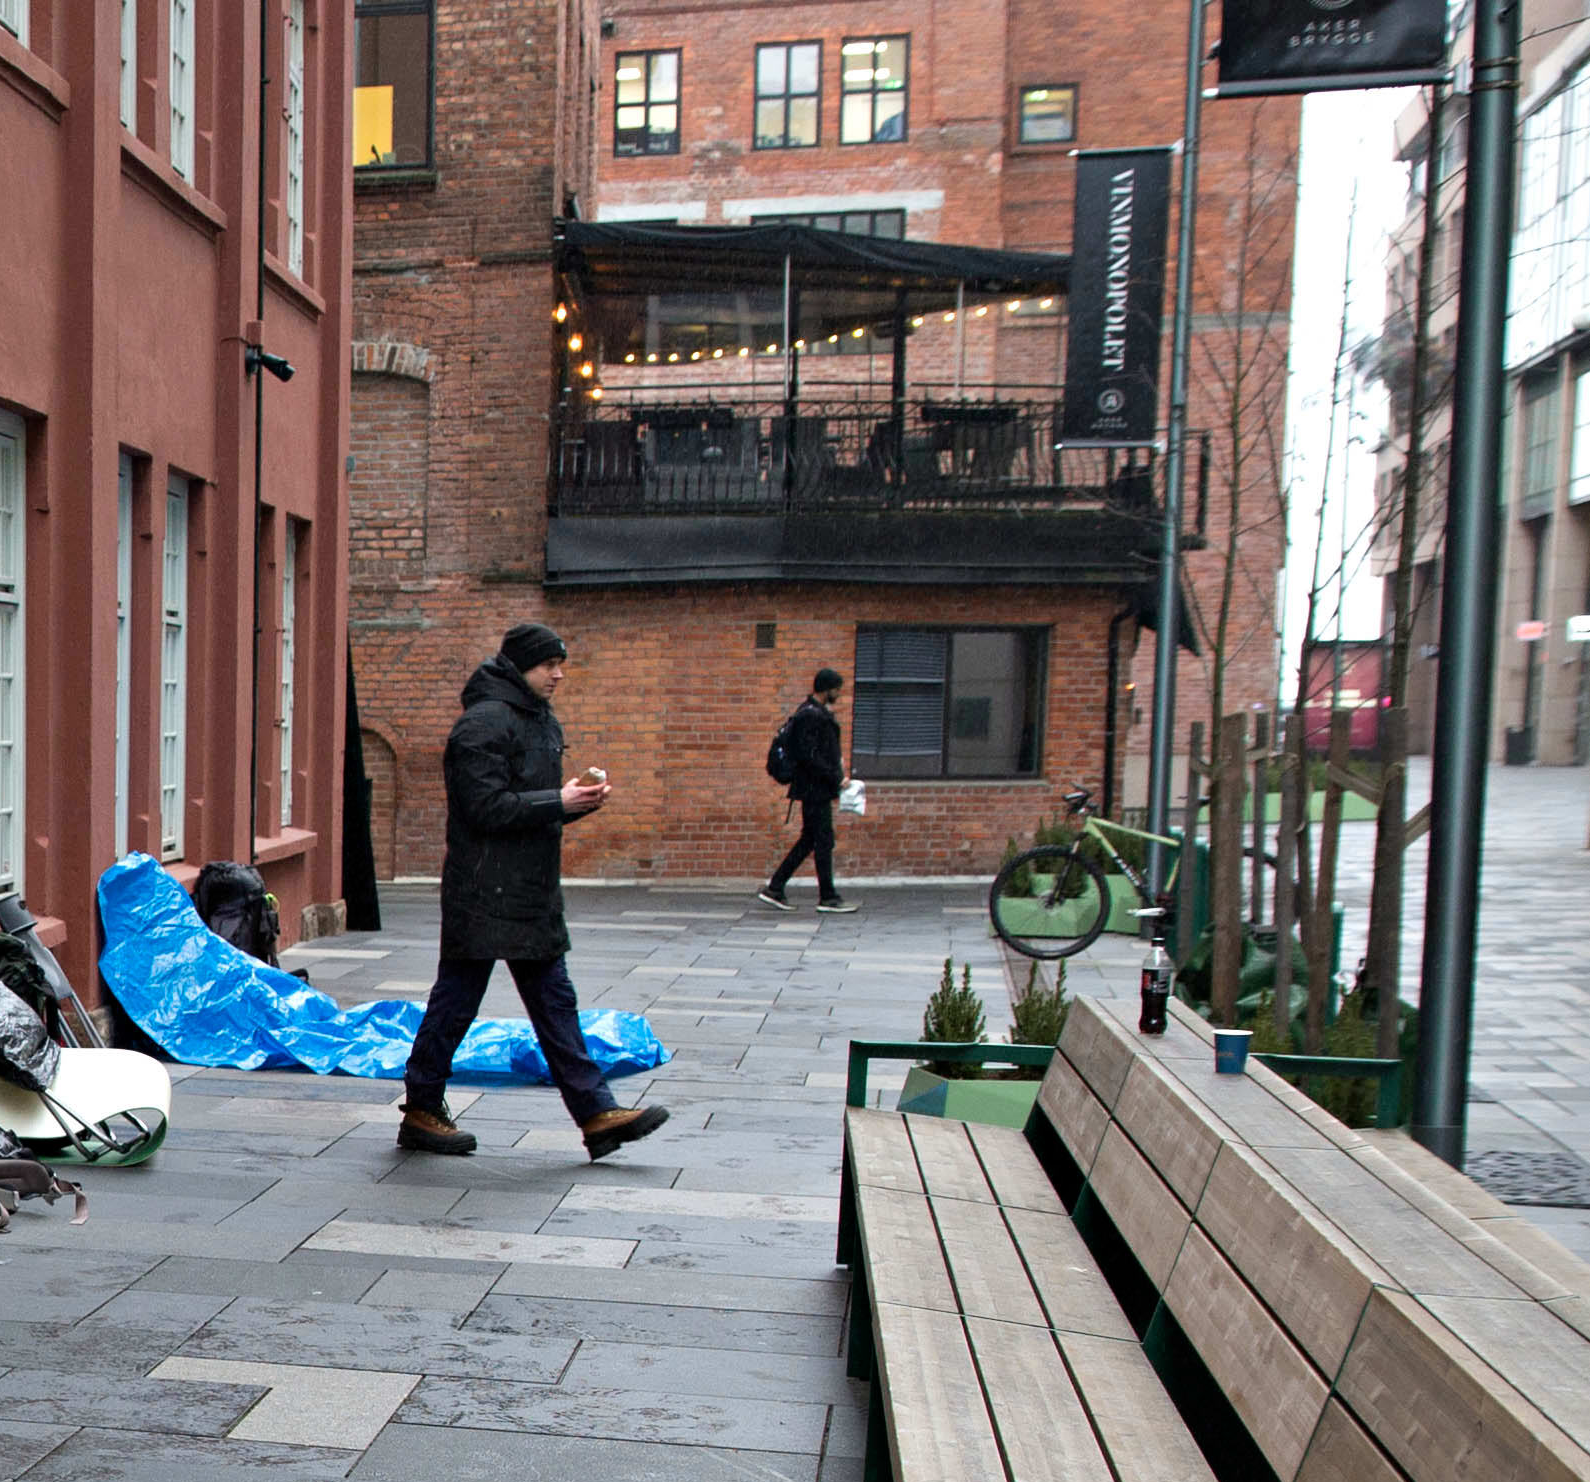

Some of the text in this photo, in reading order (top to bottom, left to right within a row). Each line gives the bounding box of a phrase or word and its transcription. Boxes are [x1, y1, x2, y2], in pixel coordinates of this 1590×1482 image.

[1303, 18, 1361, 33] AKER
[1286, 31, 1375, 48] BRYGGE
[1102, 168, 1135, 371] VINMONOPOLET
